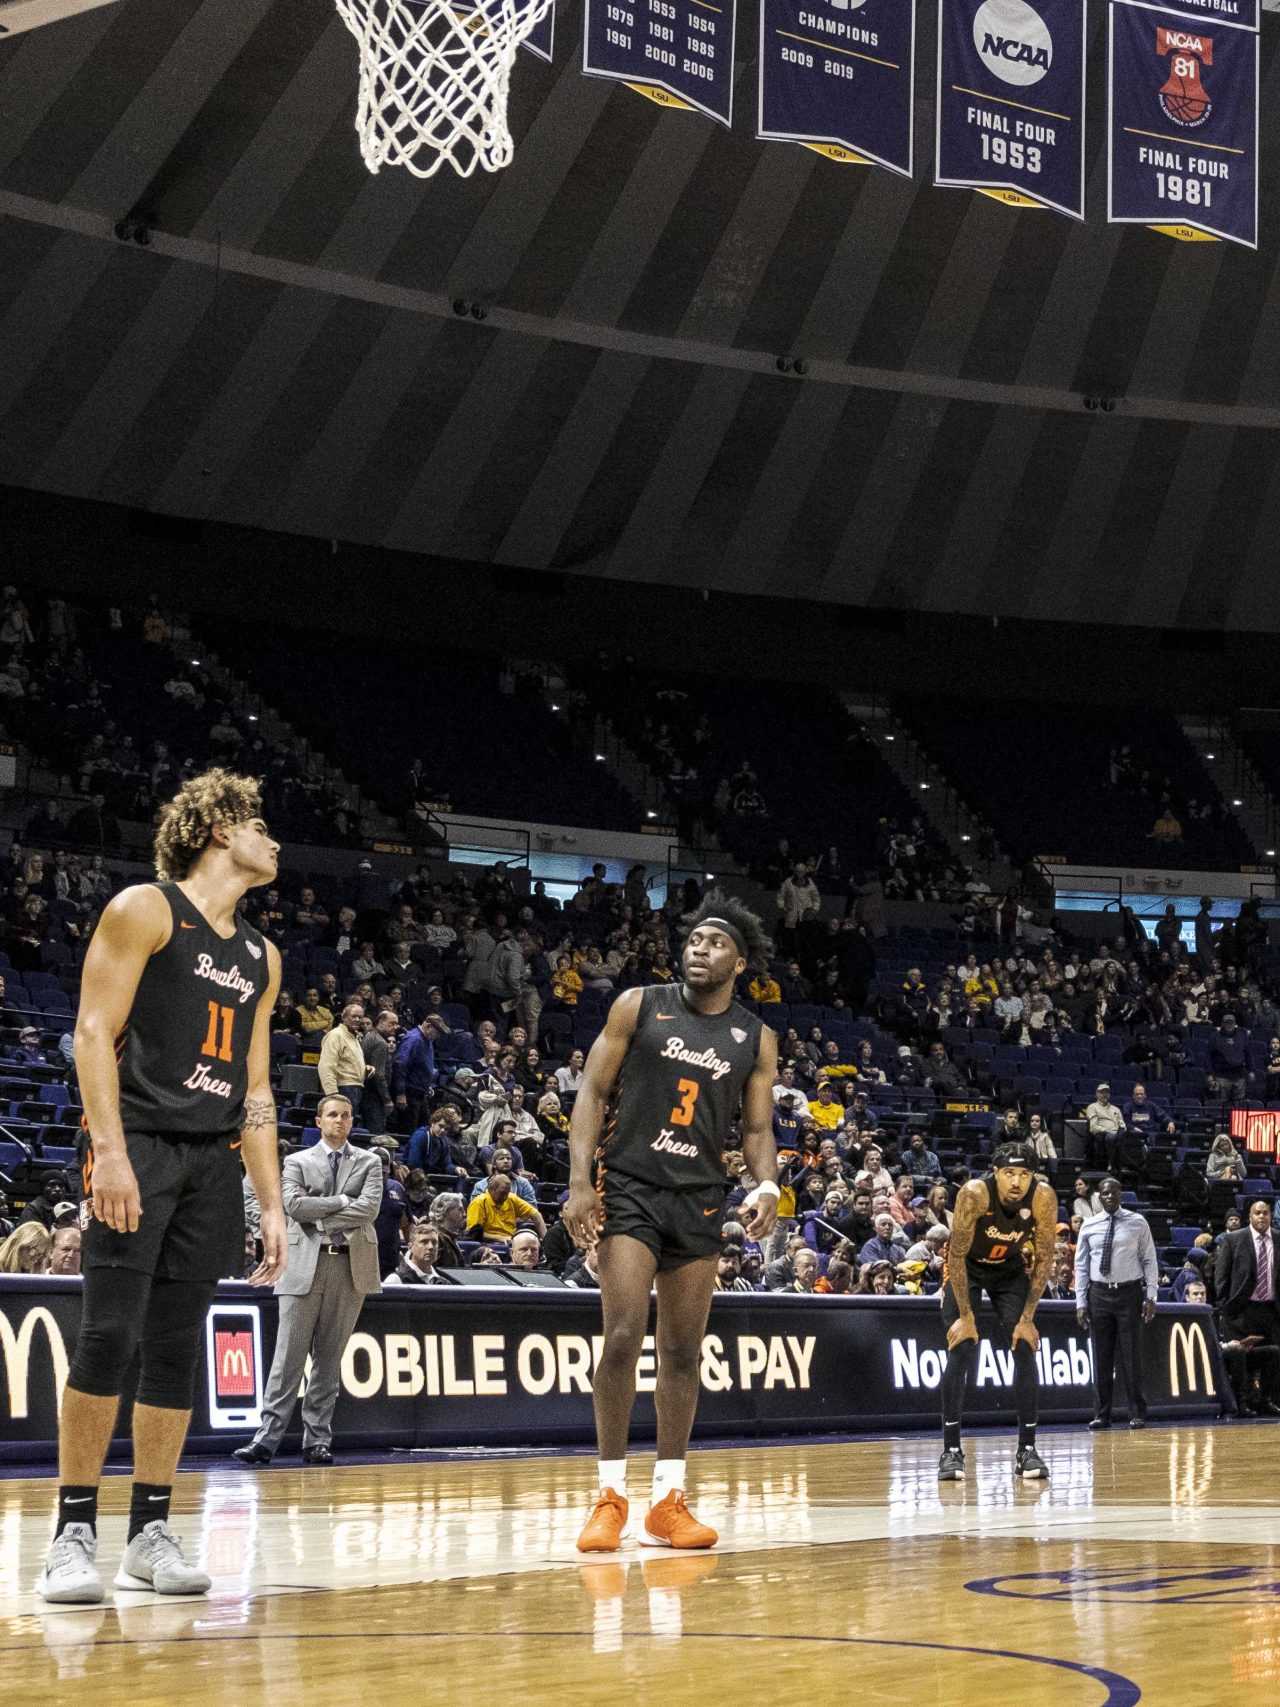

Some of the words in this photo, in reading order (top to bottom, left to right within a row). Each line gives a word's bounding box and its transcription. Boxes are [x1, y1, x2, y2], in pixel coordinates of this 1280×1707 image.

[607, 4, 634, 27] 1979
[649, 22, 674, 42] 1981
[687, 36, 715, 58] 1985
[688, 13, 715, 35] 1954
[798, 11, 879, 46] CHAMPIONS
[1166, 31, 1202, 52] NCAA
[606, 28, 632, 50] 1991
[645, 44, 676, 67] 2000
[683, 59, 714, 81] 2006
[781, 47, 814, 67] 2009
[824, 60, 854, 79] 2019
[982, 32, 1049, 71] NCAA
[1174, 57, 1195, 79] 81
[651, 90, 669, 103] LSU
[967, 106, 1010, 134] FINAL
[1015, 121, 1056, 146] FOUR
[981, 133, 1042, 174] 1953
[1139, 146, 1183, 171] FINAL
[1189, 157, 1229, 180] FOUR
[1156, 172, 1212, 208] 1981
[194, 953, 255, 1004] Bowling
[201, 1000, 235, 1064] 11
[660, 1036, 731, 1080] Bowling
[182, 1062, 233, 1099] Green
[670, 1078, 700, 1127] 3
[650, 1129, 699, 1159] Green
[990, 1245, 1008, 1259] 0
[340, 1332, 507, 1398] OBILE
[518, 1334, 656, 1395] ORE
[701, 1334, 733, 1393] &
[737, 1335, 817, 1390] PAY
[891, 1339, 948, 1388] No
[976, 1337, 1094, 1388] Avilabl
